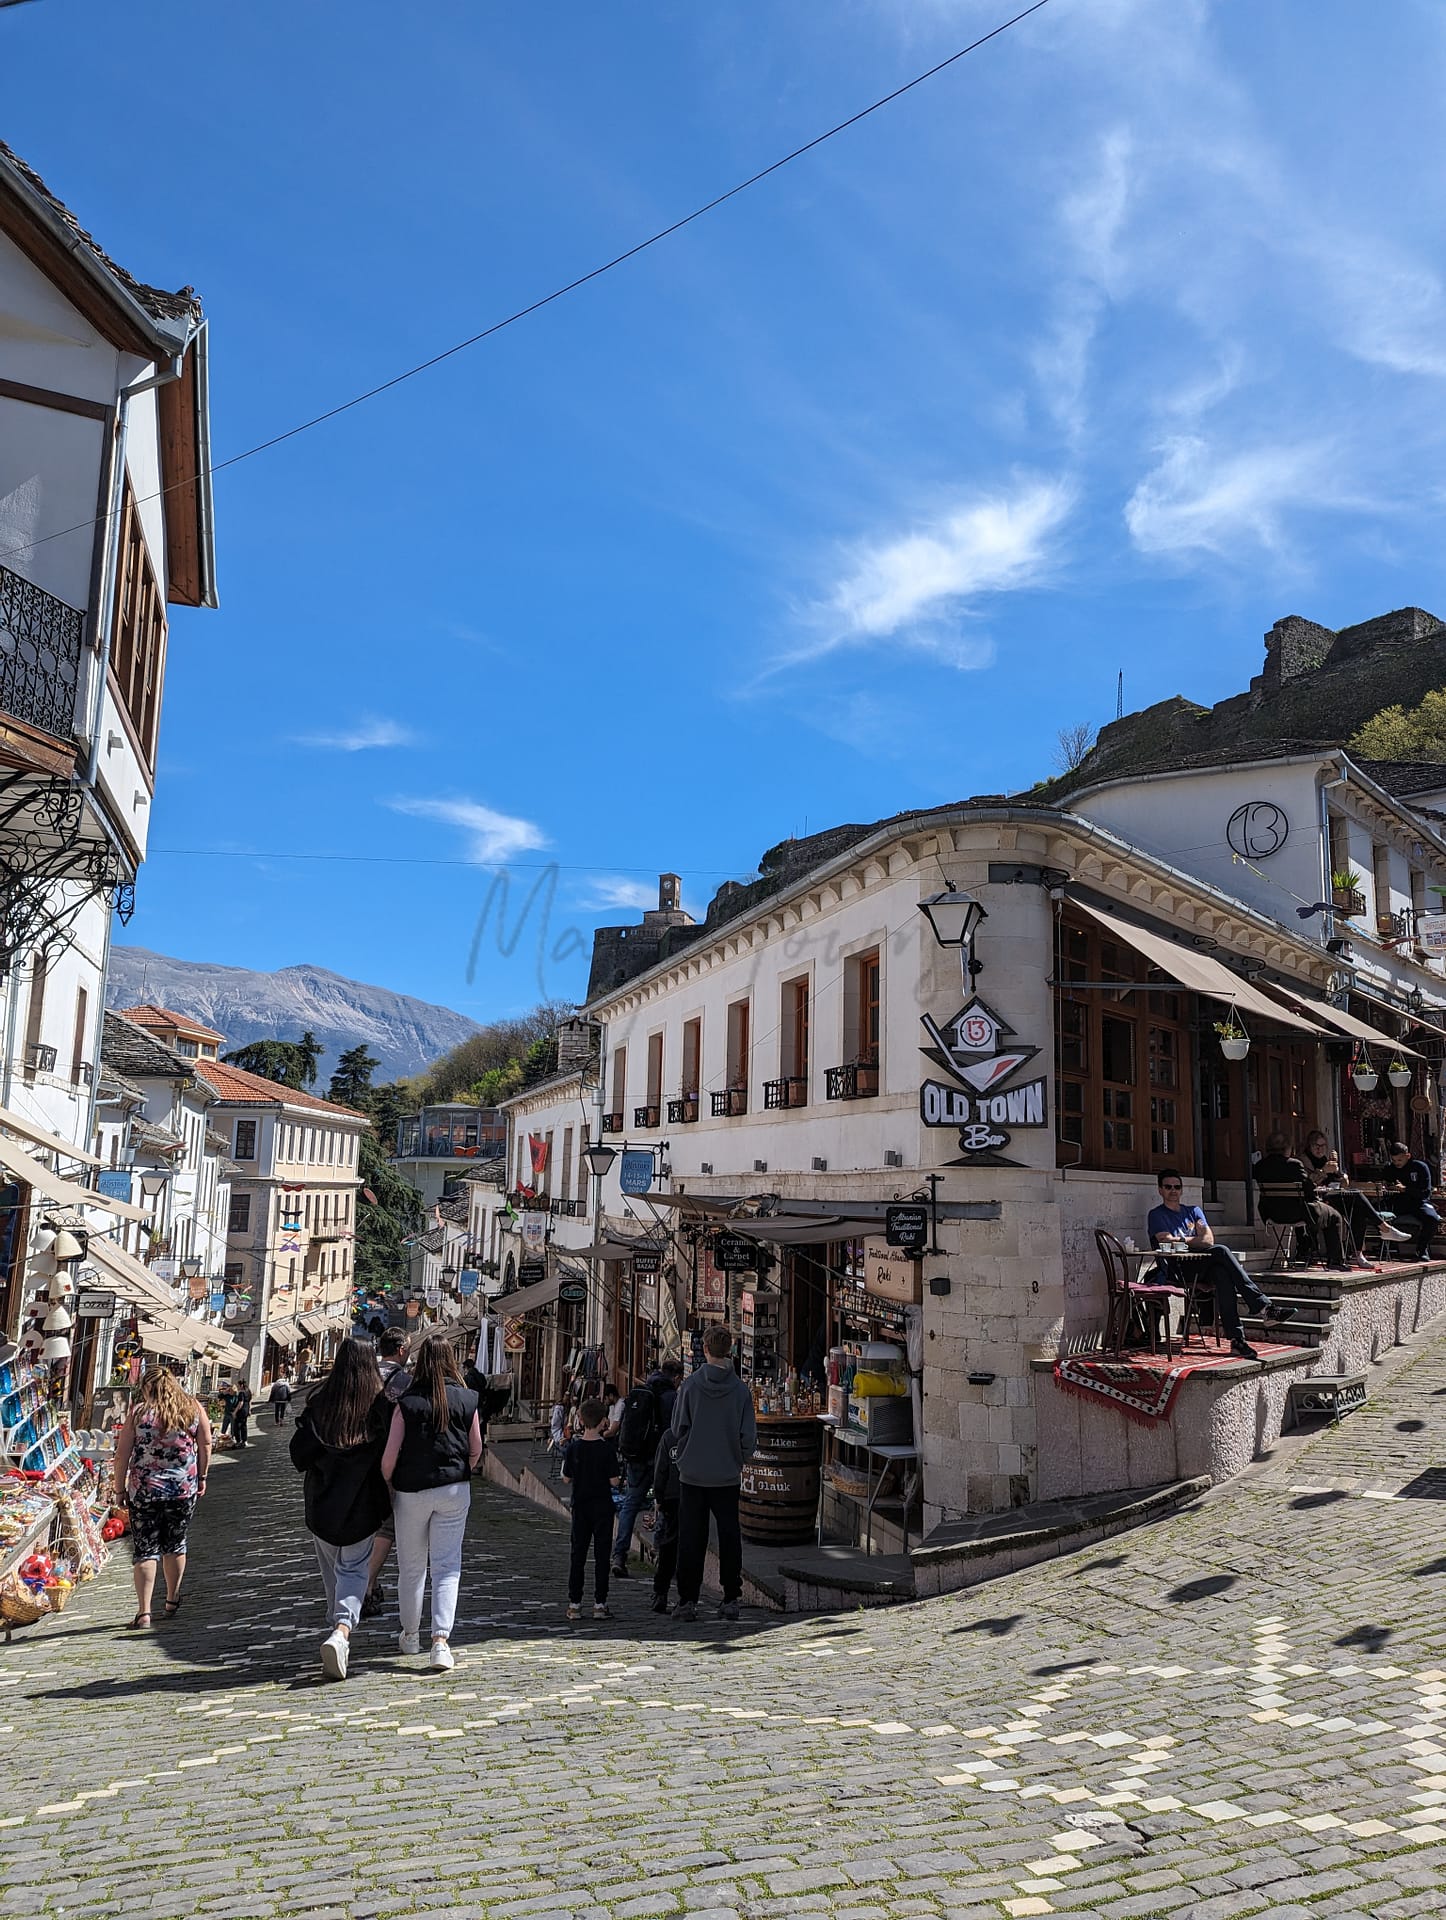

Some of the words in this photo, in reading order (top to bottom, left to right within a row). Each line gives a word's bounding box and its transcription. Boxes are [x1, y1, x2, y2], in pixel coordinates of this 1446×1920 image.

[1232, 805, 1279, 857] 13
[967, 1020, 985, 1041] 13
[924, 1083, 969, 1123] OLD
[975, 1081, 1043, 1123] TOWN
[963, 1123, 1005, 1149] Bar
[625, 1178, 647, 1187] MARS
[890, 1211, 922, 1222] Albanian
[890, 1221, 924, 1232] Traditional
[898, 1231, 916, 1242] Raki
[877, 1266, 892, 1284] Raki
[770, 1438, 798, 1447] Liker
[742, 1464, 784, 1477] Botanikal
[758, 1480, 791, 1492] Glauk
